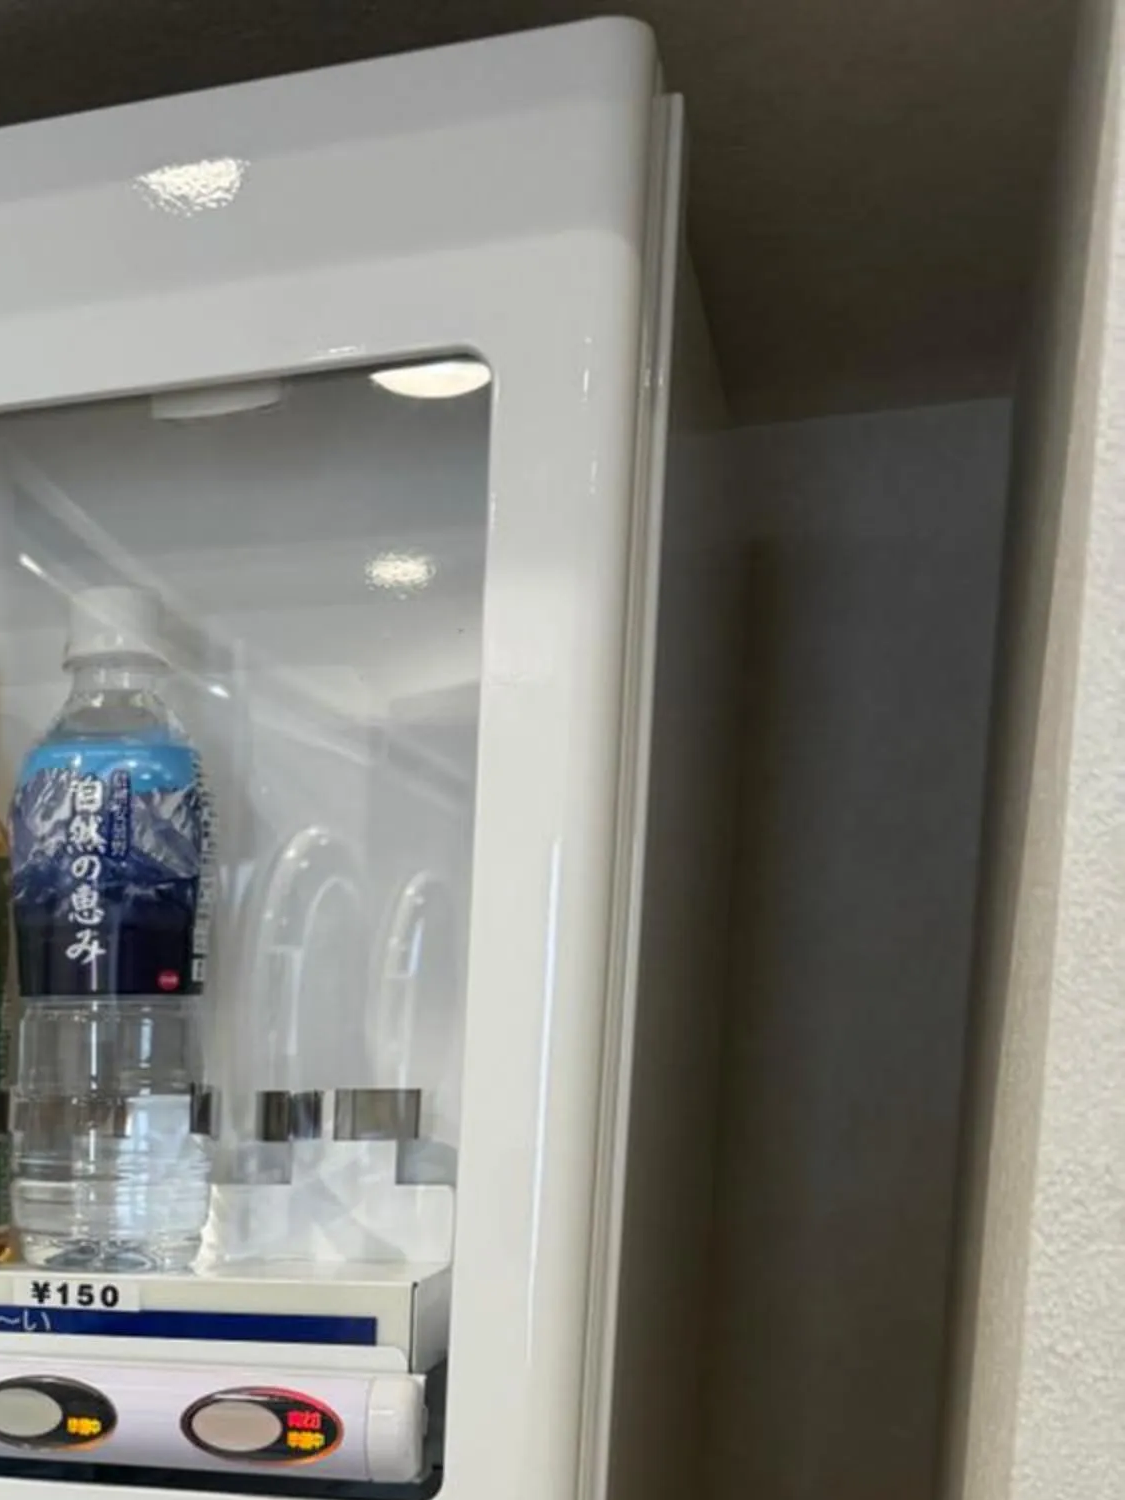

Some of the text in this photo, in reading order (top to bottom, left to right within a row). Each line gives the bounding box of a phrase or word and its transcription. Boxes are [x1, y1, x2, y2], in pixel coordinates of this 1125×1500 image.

[65, 777, 106, 968] 自然の恵み
[31, 1280, 120, 1308] ¥150
